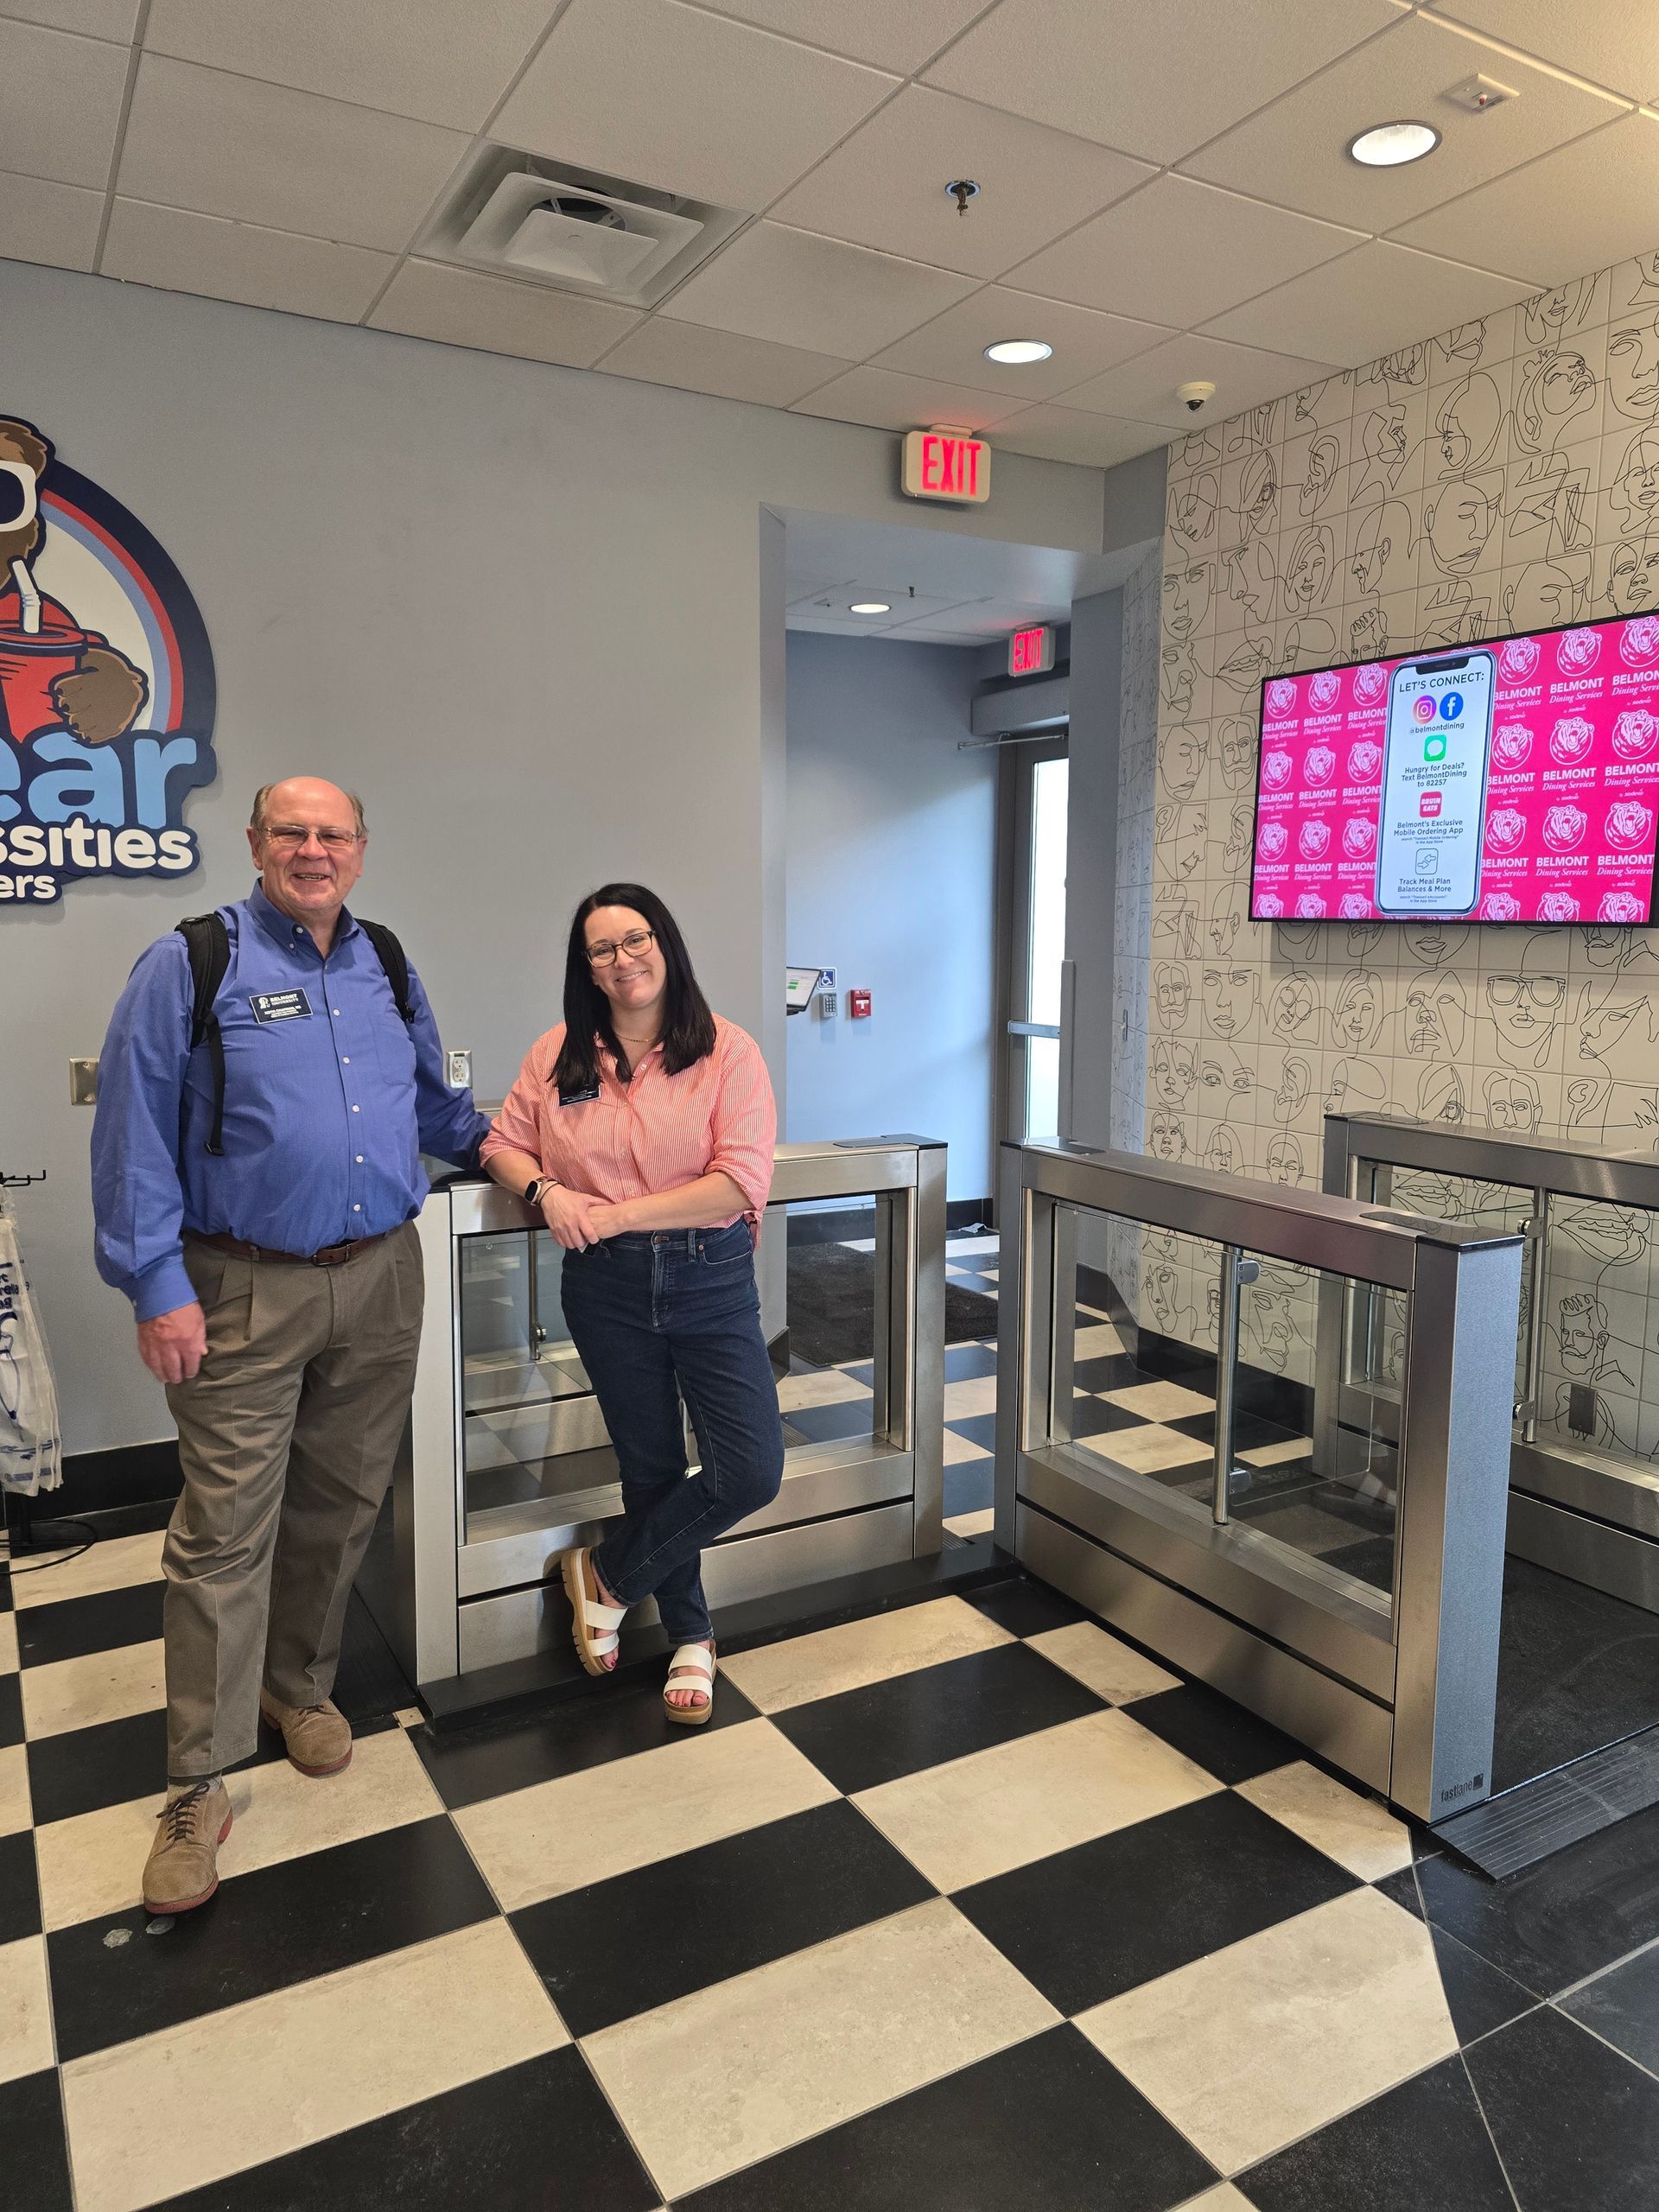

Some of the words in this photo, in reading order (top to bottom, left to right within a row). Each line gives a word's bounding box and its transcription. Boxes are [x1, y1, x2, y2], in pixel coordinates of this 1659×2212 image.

[922, 435, 982, 496] EXIT
[1013, 627, 1044, 673] EXIT
[1399, 680, 1427, 692] LET'S
[1429, 671, 1484, 688] CONNECT:
[1550, 677, 1605, 694] BELMONT
[1494, 685, 1543, 702] BELMONT
[1549, 695, 1573, 704] Dining
[1574, 690, 1603, 701] Services
[1611, 687, 1638, 696] Dining
[1516, 699, 1542, 708] Services
[1348, 707, 1387, 721] BELMONT
[1262, 720, 1299, 732] BELMONT
[1303, 714, 1343, 727] BELMONT
[1347, 721, 1366, 730] Dining
[1410, 722, 1465, 734] @belmontdining
[1442, 762, 1465, 771] Deals?
[1605, 762, 1659, 777] BELMONT
[1417, 770, 1467, 780] BelmontDining
[1486, 772, 1535, 785] BELMONT
[1543, 767, 1597, 781] BELMONT
[0, 731, 197, 830] ar
[1542, 782, 1567, 791] Dining
[1568, 780, 1596, 789] Services
[1605, 778, 1631, 787] Dining
[1299, 789, 1338, 800] BELMONT
[1343, 785, 1382, 797] BELMONT
[1509, 784, 1535, 793] Services
[1258, 792, 1294, 804] BELMONT
[1417, 827, 1447, 836] Ordering
[0, 817, 194, 870] sities
[1481, 857, 1529, 868] BELMONT
[1536, 856, 1589, 867] BELMONT
[1598, 854, 1655, 866] BELMONT
[1254, 864, 1290, 874] BELMONT
[1294, 862, 1332, 873] BELMONT
[1338, 861, 1376, 872] BELMONT
[1503, 868, 1528, 877] Services
[1597, 867, 1624, 877] Dining
[1624, 867, 1653, 875] Services
[1535, 868, 1560, 878] Dining
[1561, 868, 1589, 876] Services
[1440, 1780, 1473, 1802] fastlane
